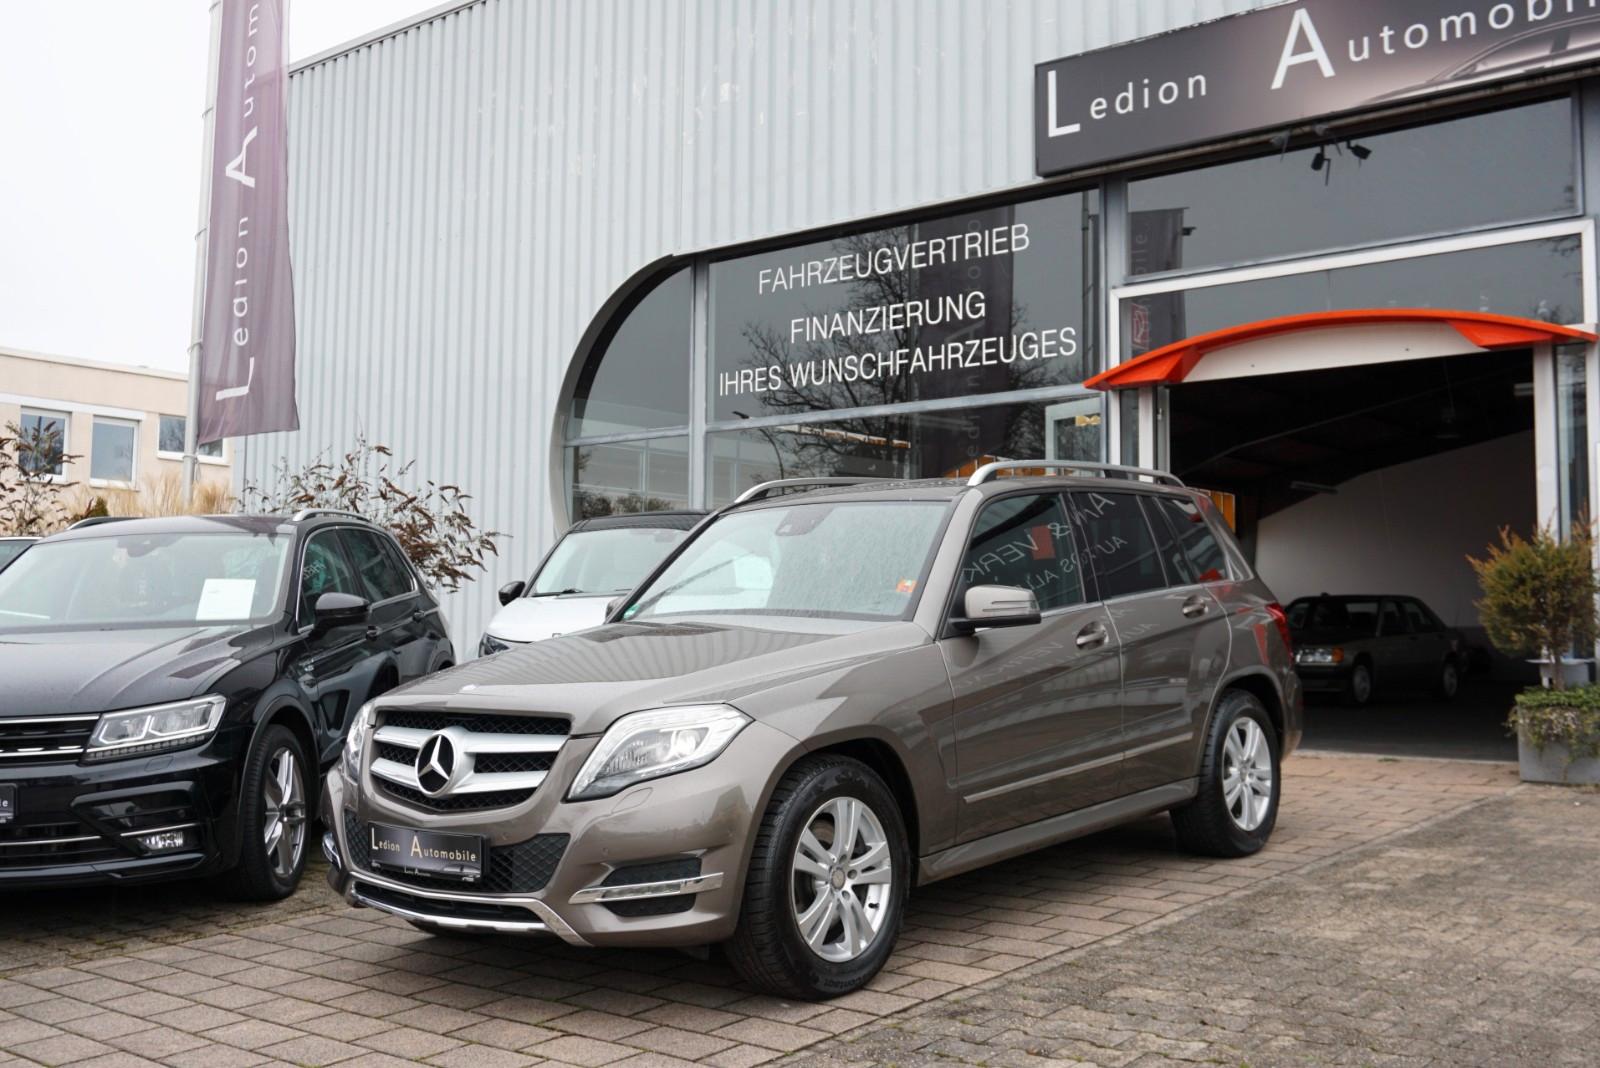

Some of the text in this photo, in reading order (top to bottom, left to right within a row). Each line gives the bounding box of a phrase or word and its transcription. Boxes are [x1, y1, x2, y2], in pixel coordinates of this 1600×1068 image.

[1047, 70, 1207, 138] Ledion
[759, 223, 1031, 295] FAHRZEUGVERTRIEB
[216, 217, 255, 401] Ledion
[790, 290, 986, 344] FINANZIERUNG
[719, 326, 1078, 397] IHRES WUNSCHFAHRZEUGES
[371, 827, 477, 862] Ledion Automobile
